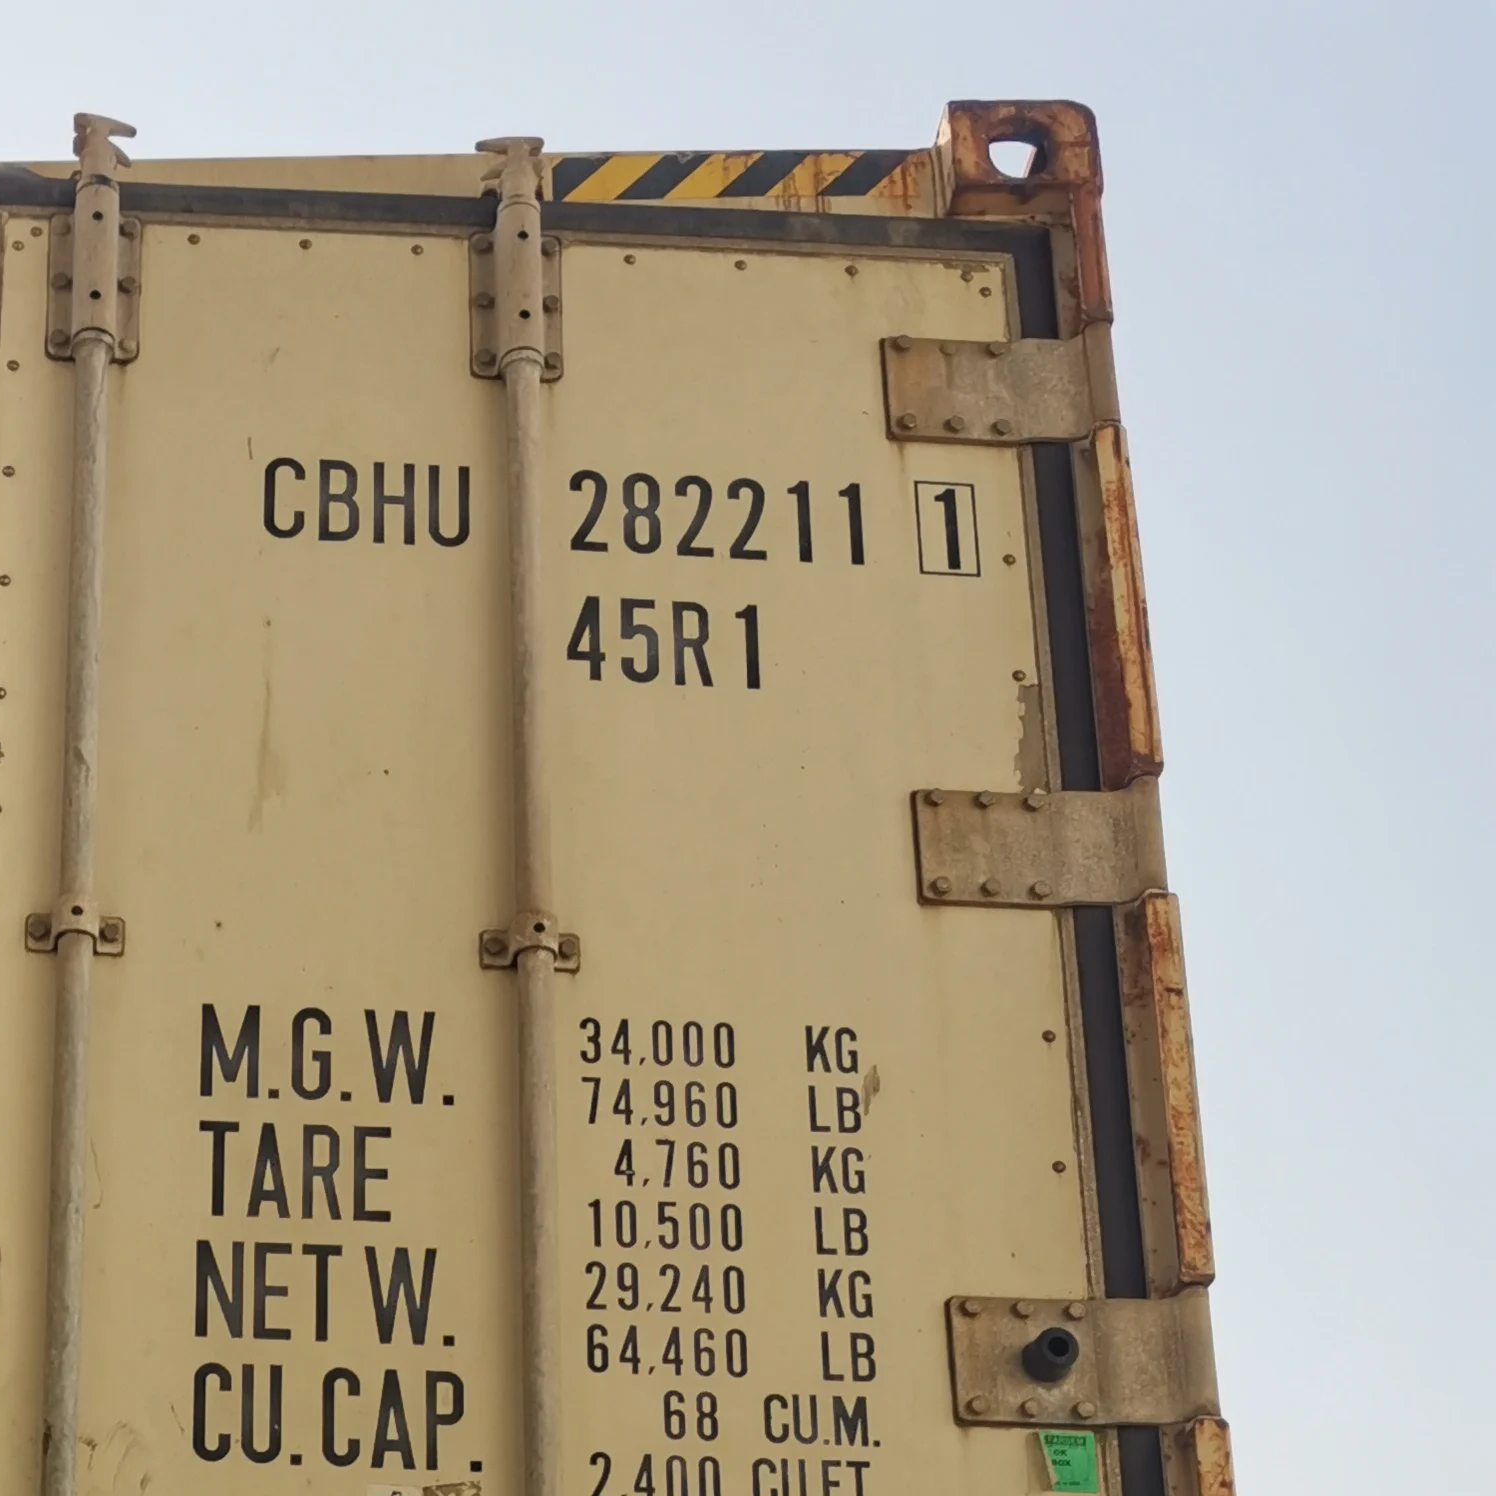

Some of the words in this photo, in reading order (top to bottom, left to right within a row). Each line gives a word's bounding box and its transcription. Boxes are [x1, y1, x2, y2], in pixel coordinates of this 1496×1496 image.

[263, 458, 471, 547] CBHU
[569, 469, 866, 565] 282211
[932, 489, 963, 570] 1
[566, 595, 761, 689] 45R1
[200, 1004, 455, 1106] M.G.W.
[579, 1018, 735, 1069] 34,000
[806, 1026, 858, 1074] KG
[581, 1078, 738, 1129] 74,960
[808, 1085, 862, 1134] LB
[200, 1120, 392, 1222] TARE
[613, 1140, 740, 1191] 4,760
[812, 1146, 866, 1194] KG
[587, 1200, 743, 1251] 10,500
[814, 1208, 868, 1256] LB
[194, 1241, 342, 1341] NET
[366, 1248, 455, 1346] W.
[585, 1262, 745, 1314] 29,240
[816, 1269, 873, 1318] KG
[586, 1324, 748, 1378] 64,460
[822, 1333, 876, 1382] LB
[663, 1391, 718, 1441] 68
[763, 1395, 881, 1448] CU.M.
